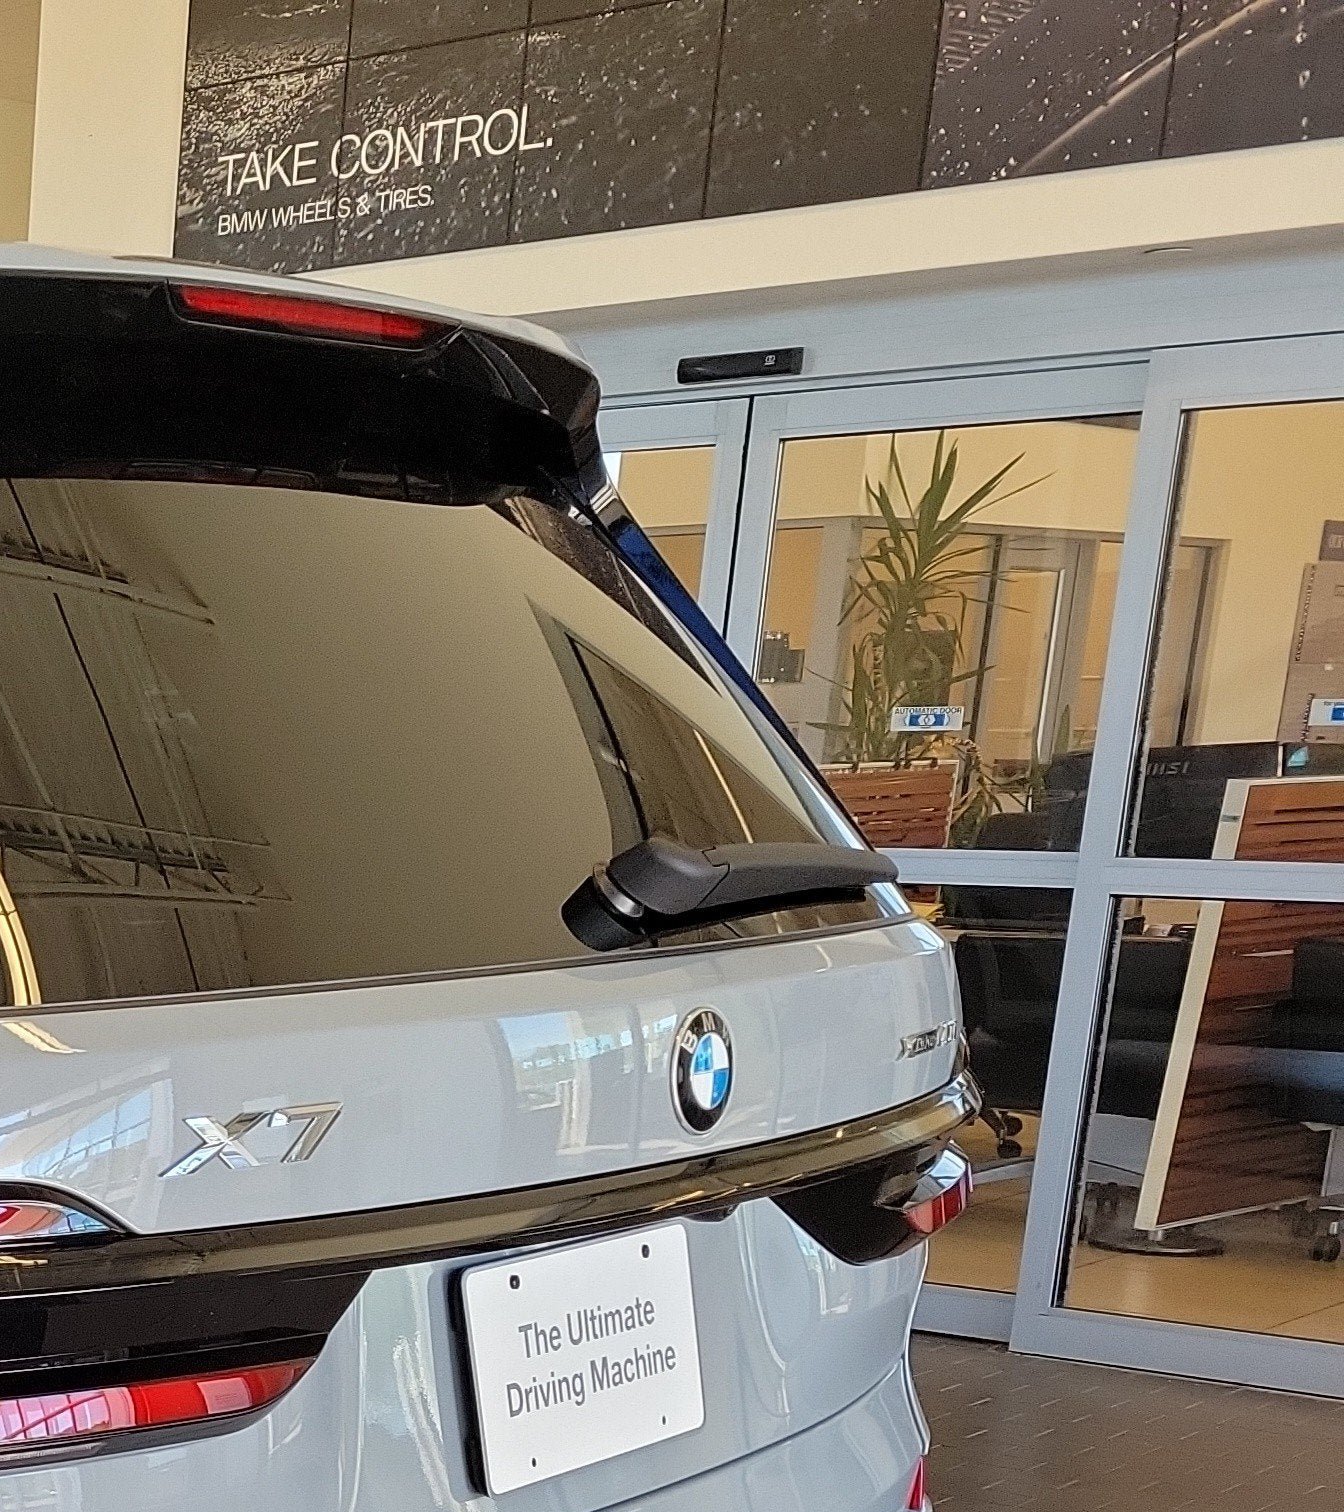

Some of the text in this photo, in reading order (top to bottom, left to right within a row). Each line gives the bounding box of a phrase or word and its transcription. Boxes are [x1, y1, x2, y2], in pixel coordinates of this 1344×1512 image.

[218, 103, 554, 197] TAKE CONTROL.
[217, 184, 435, 236] BMW WHEELS & TIRES.
[894, 706, 962, 715] AUTOMATIC DOOR
[158, 1101, 344, 1178] X7
[518, 1297, 656, 1358] The Ultimate
[506, 1344, 677, 1418] Driving Machine
